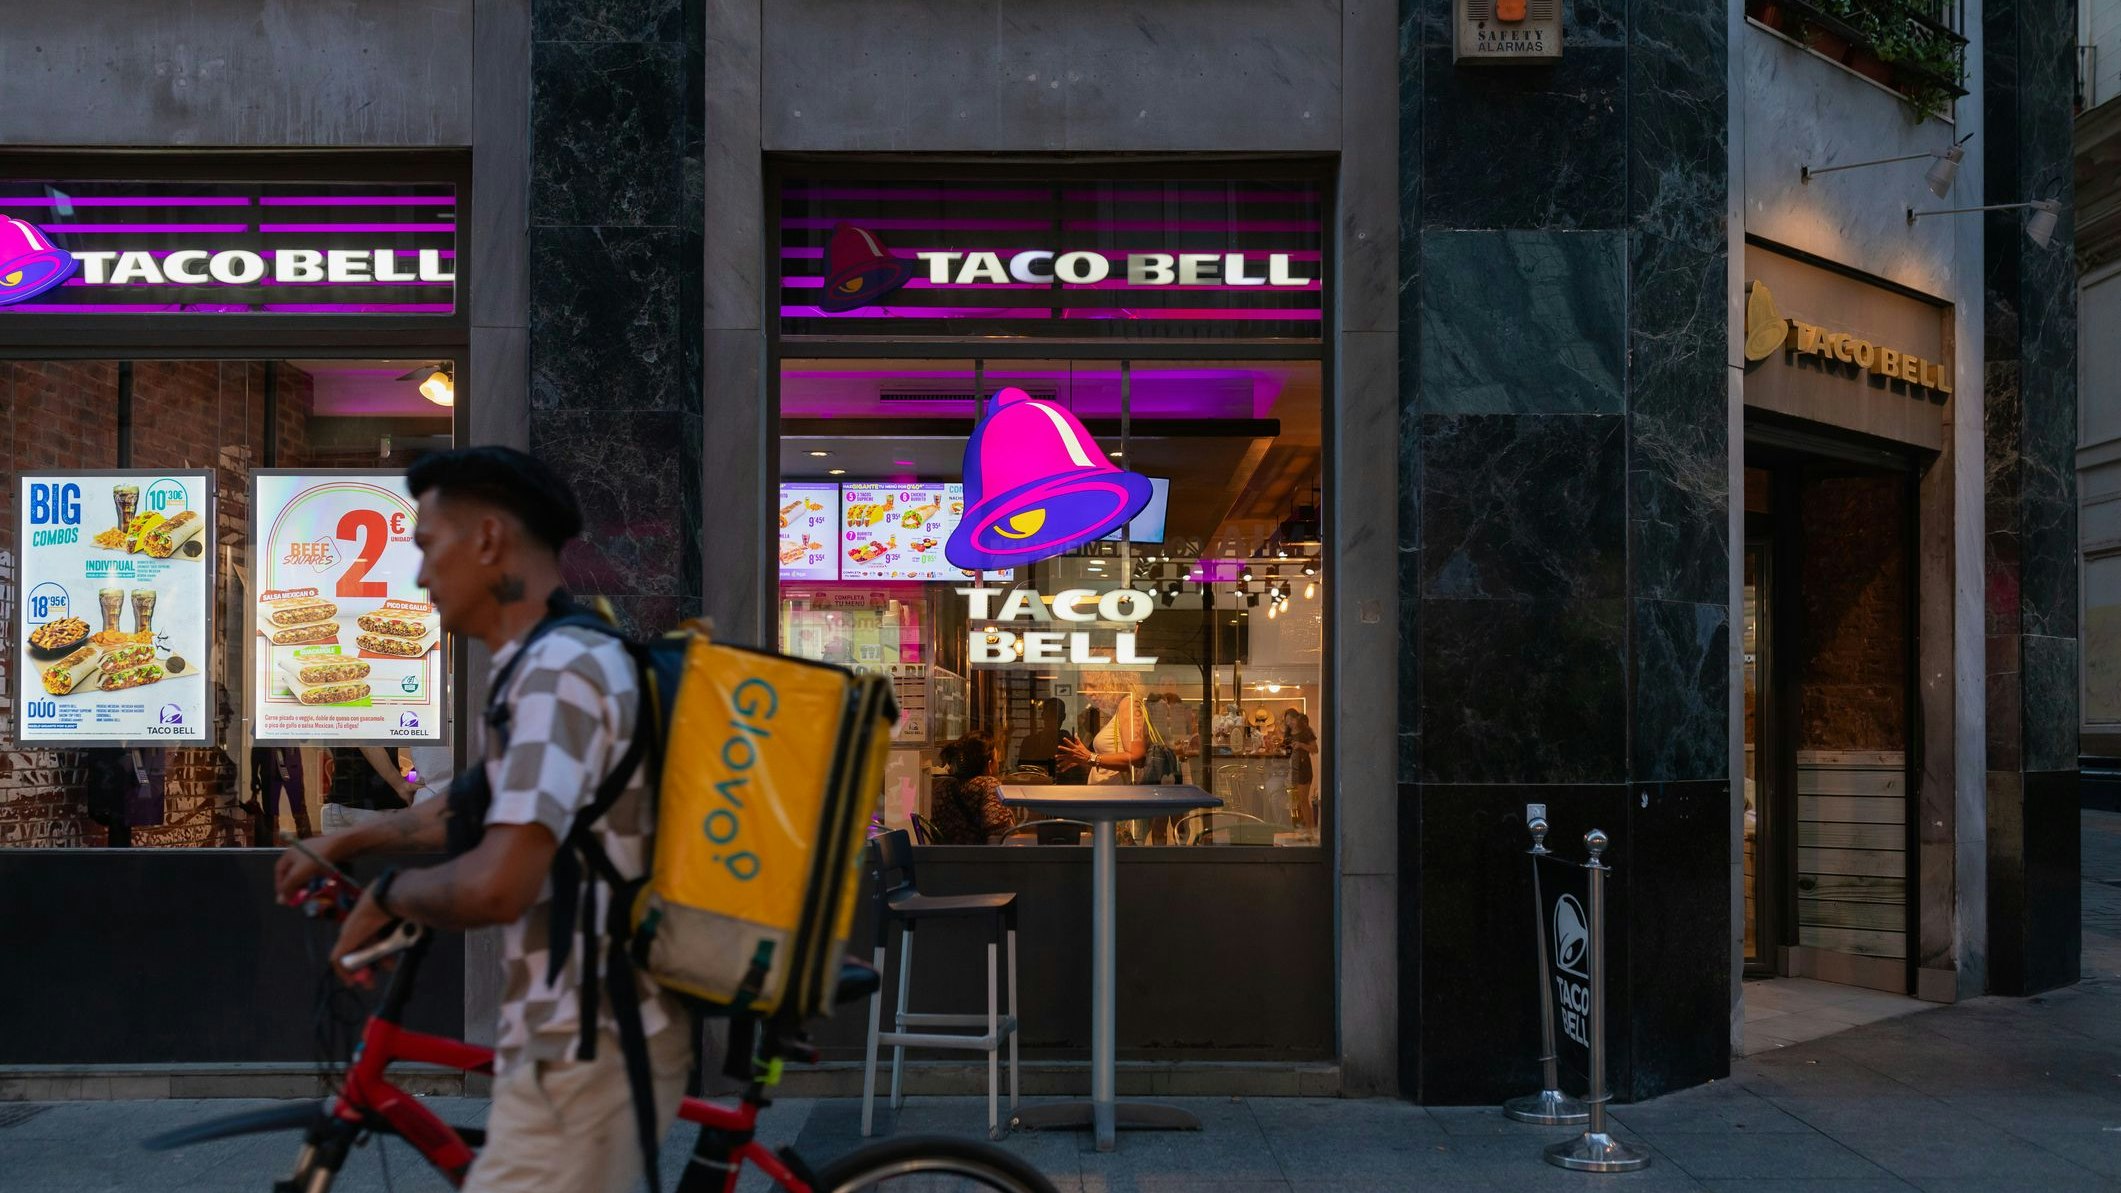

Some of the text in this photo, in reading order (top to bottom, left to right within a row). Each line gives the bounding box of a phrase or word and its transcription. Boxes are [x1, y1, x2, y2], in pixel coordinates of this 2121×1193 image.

[1478, 30, 1543, 41] SAFETY
[1478, 41, 1543, 52] ALARMAS
[71, 249, 456, 284] TACO BELL
[916, 250, 1311, 286] TACO BELL
[1789, 319, 1953, 394] TACO BELL
[30, 483, 81, 525] BIG
[32, 527, 79, 547] COMBOS
[290, 542, 330, 556] BEEF
[336, 509, 405, 598] 2 €
[86, 560, 136, 571] INDIVIDUAL
[282, 555, 334, 566] SQUARES
[263, 590, 309, 601] SALSA MEXICAN
[956, 587, 1154, 623] TACO
[386, 601, 401, 609] PICO
[409, 604, 428, 612] GALLO
[968, 630, 1159, 665] BELL
[28, 697, 56, 718] DÚO
[147, 726, 172, 735] TACO
[173, 726, 196, 735] BELL
[1556, 975, 1590, 1016] TACO
[1560, 1007, 1590, 1048] BELL
